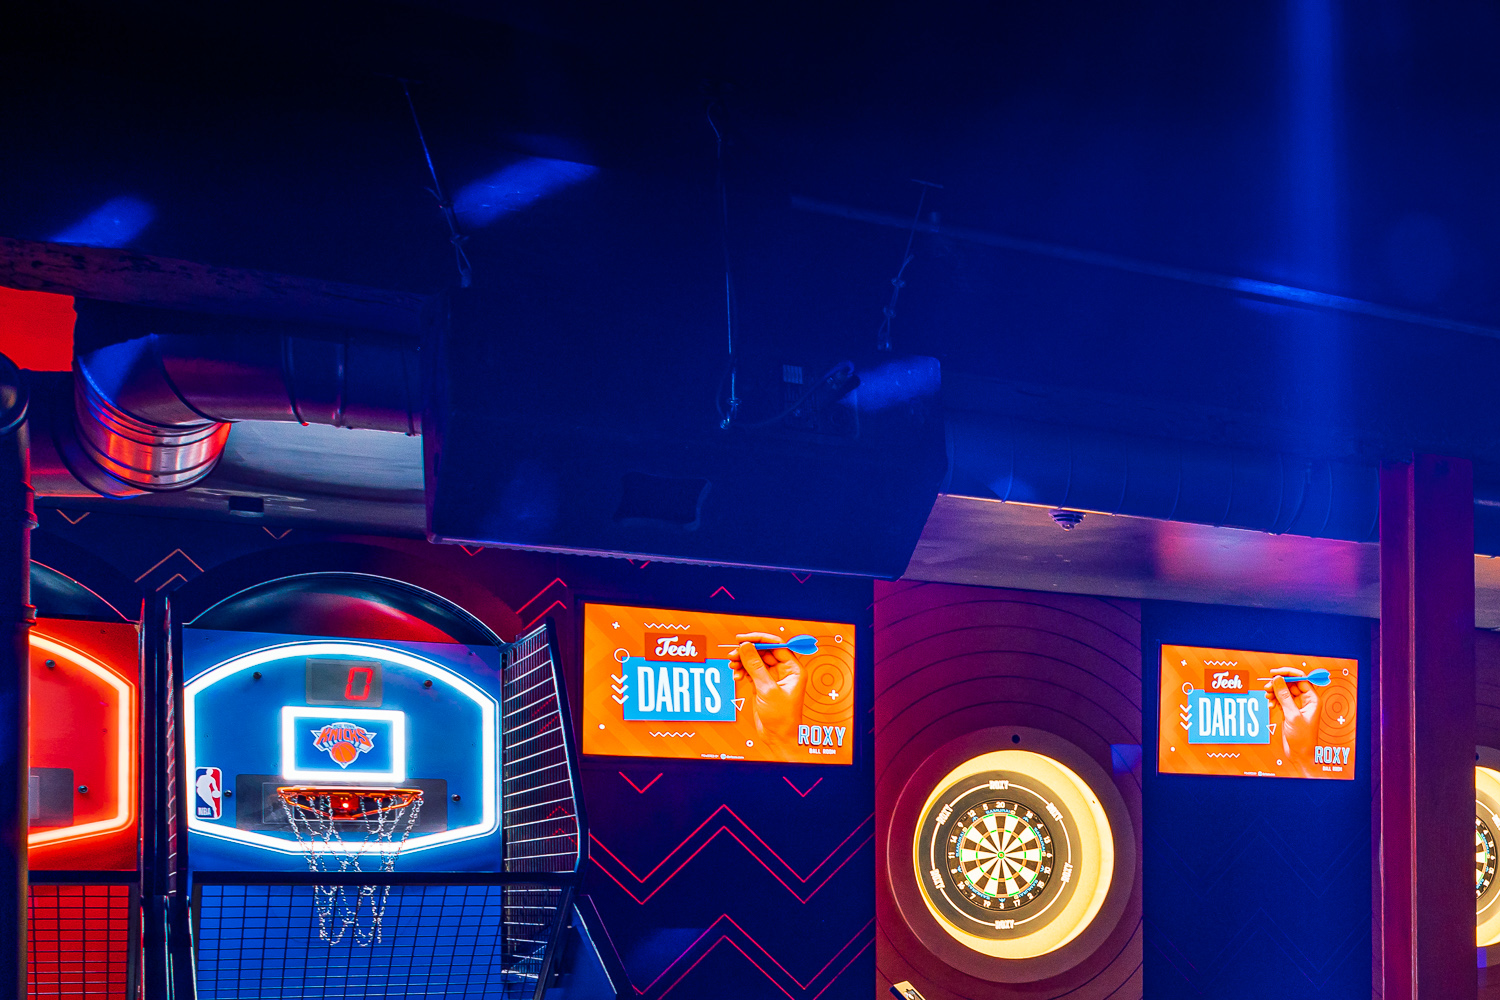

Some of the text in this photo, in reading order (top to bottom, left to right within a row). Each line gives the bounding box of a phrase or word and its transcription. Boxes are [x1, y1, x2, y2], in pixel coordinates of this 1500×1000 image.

[655, 636, 698, 657] Tech
[344, 667, 373, 701] 0
[637, 666, 721, 714] DARTS
[1212, 671, 1243, 689] Tech
[1198, 697, 1260, 738] DARTS
[316, 727, 372, 747] KNICKS
[798, 725, 847, 747] ROXY
[1314, 746, 1350, 765] ROXY
